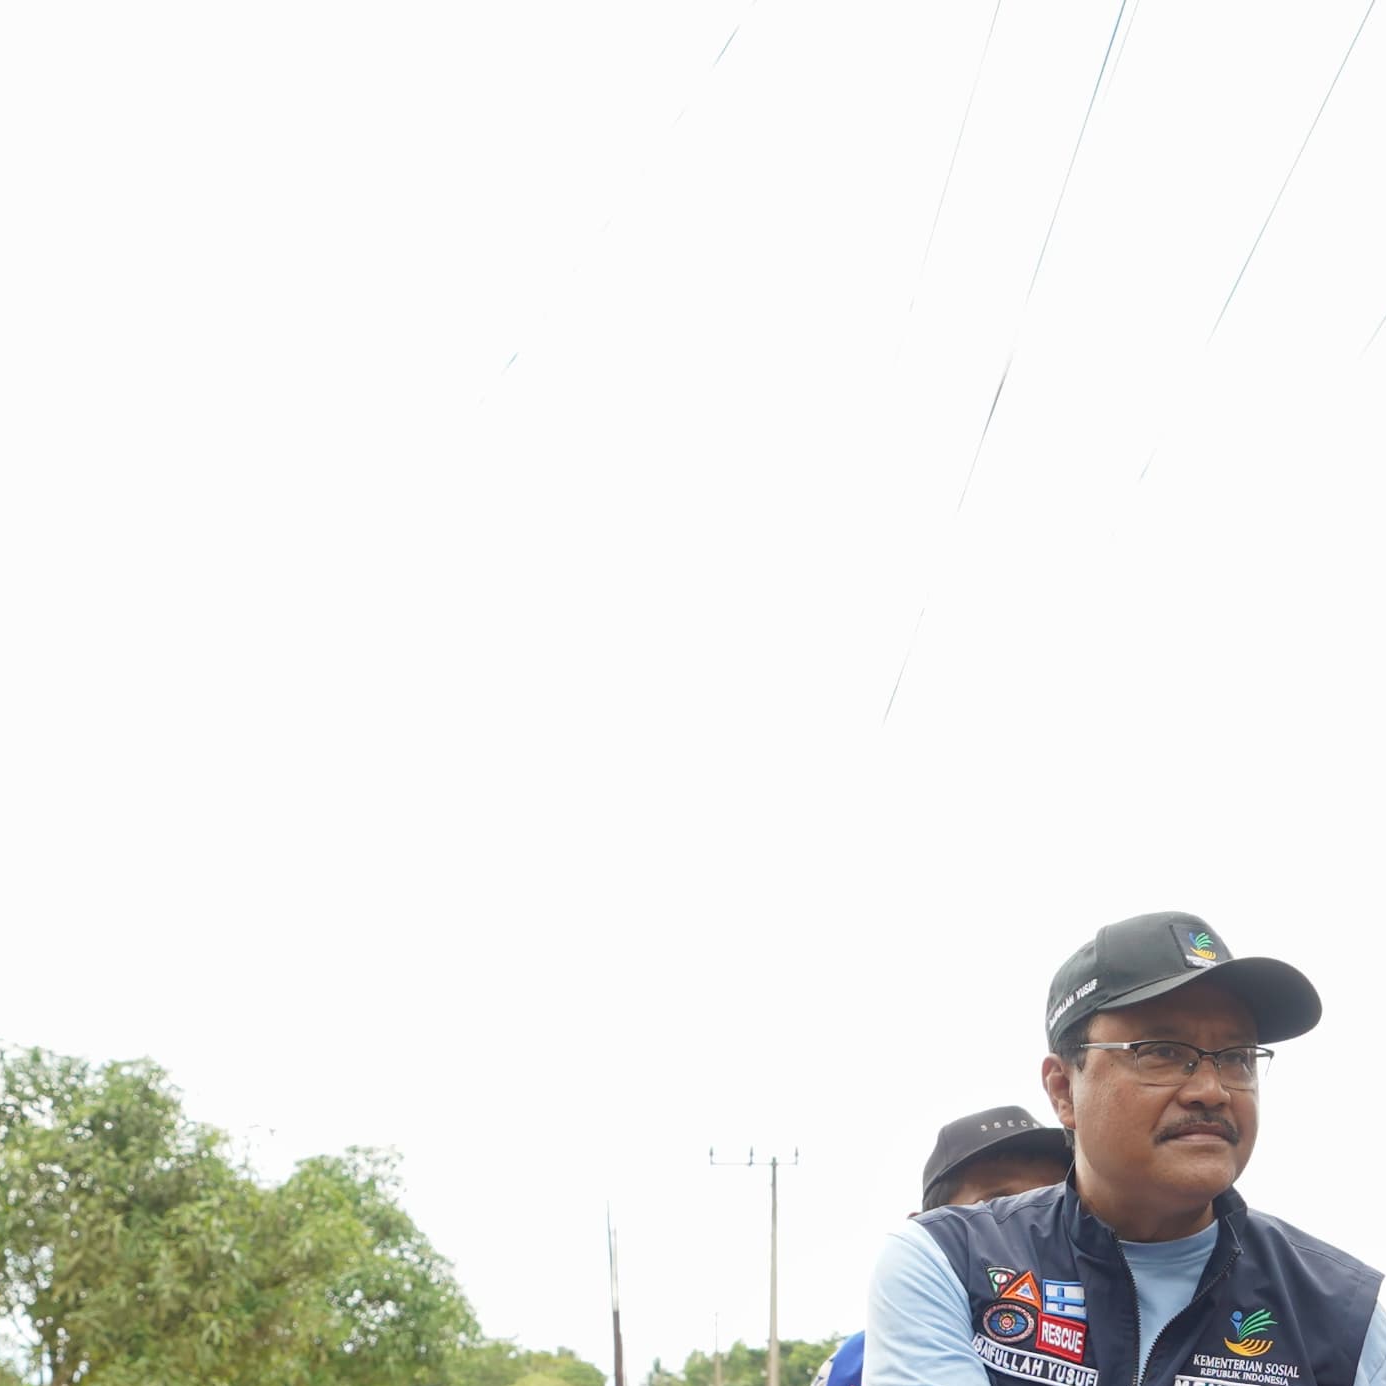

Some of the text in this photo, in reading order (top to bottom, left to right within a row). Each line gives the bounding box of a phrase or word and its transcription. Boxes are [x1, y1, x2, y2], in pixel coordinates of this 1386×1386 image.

[1041, 1321, 1084, 1354] RESCUE
[974, 1337, 1044, 1377] SAIFULLAH
[1193, 1353, 1300, 1379] KEMENTERIAN SOSIAL
[1200, 1367, 1289, 1386] REPUBLIK INDONESIA
